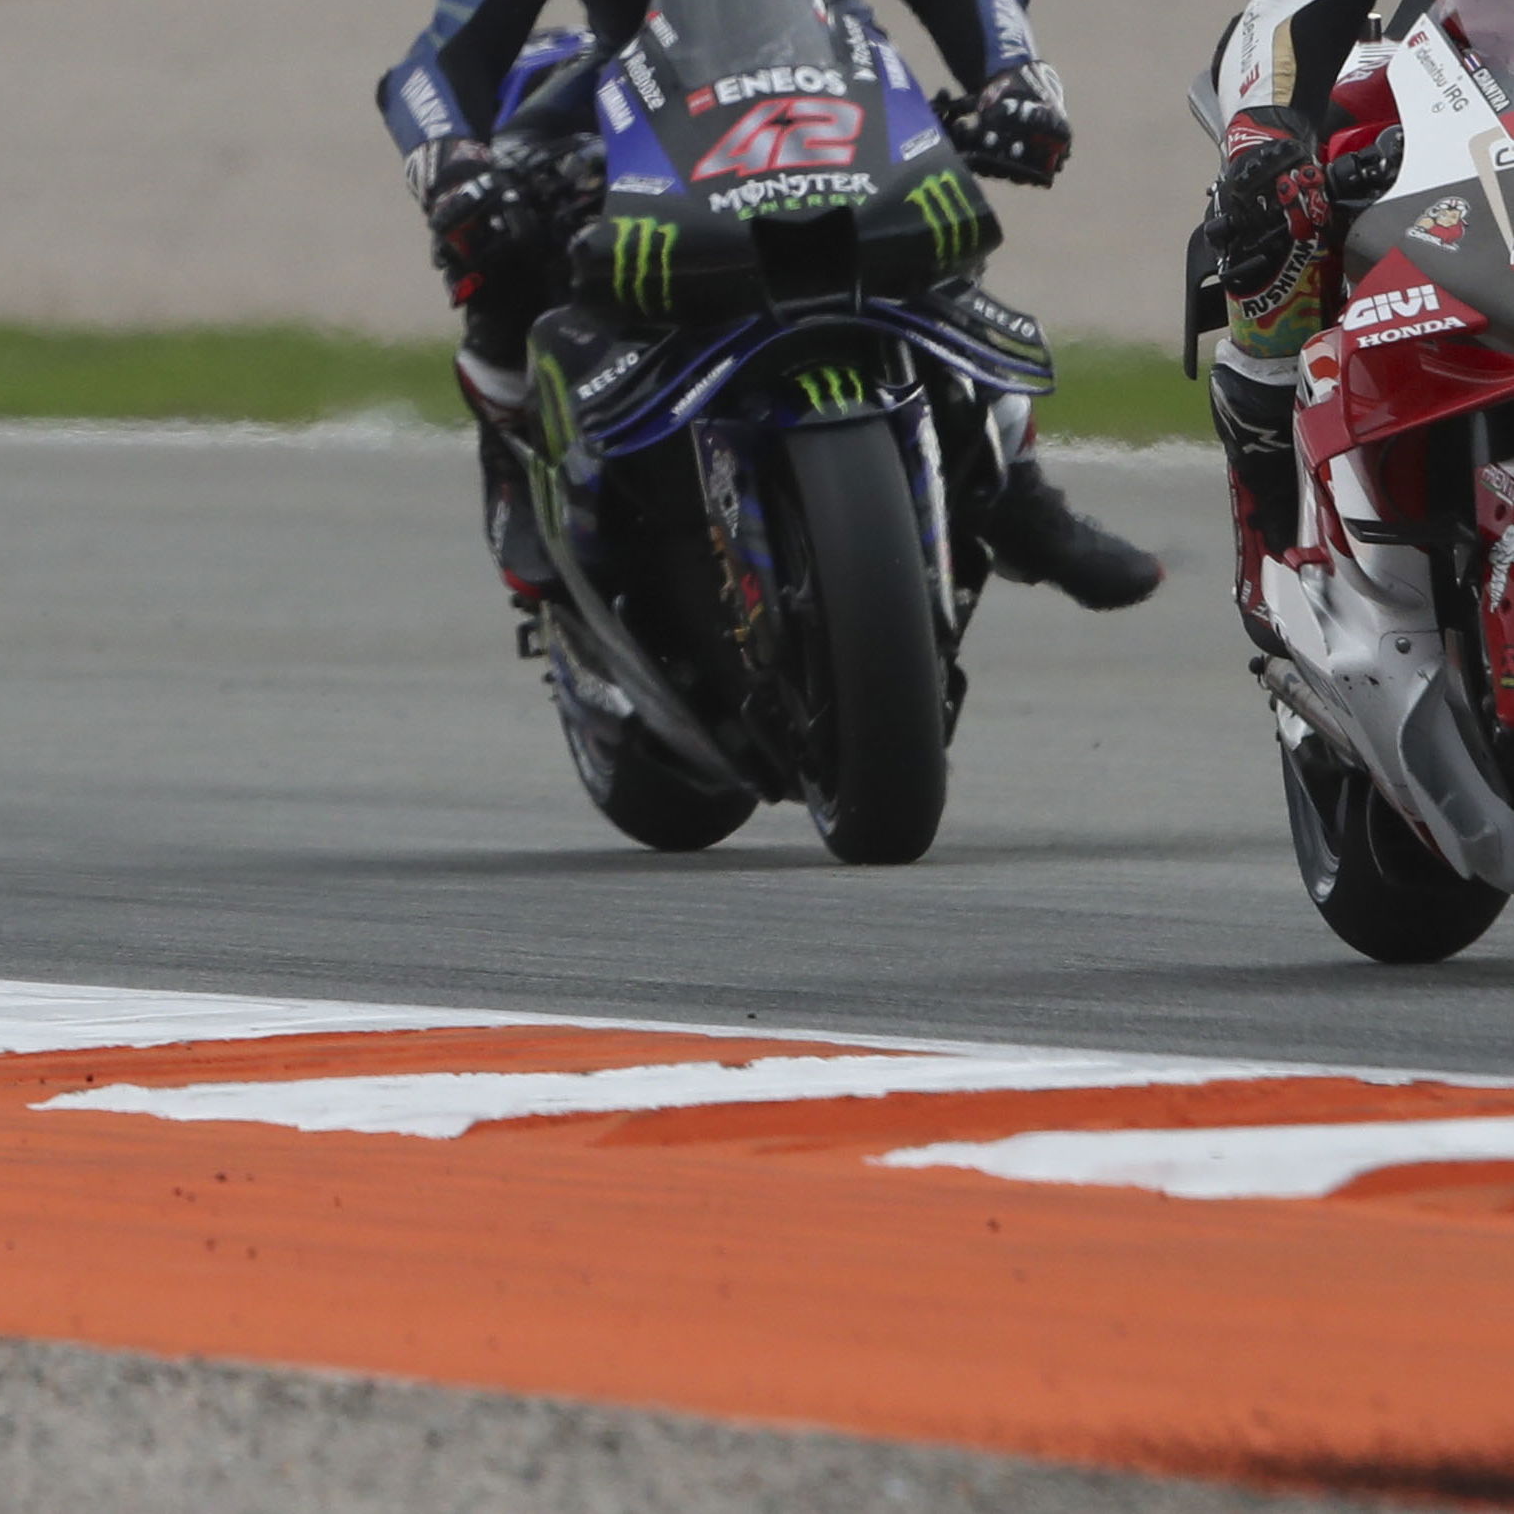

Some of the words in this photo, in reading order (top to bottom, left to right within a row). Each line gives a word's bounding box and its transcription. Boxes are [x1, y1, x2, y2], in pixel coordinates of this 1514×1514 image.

[713, 65, 848, 106] ENEOS
[1442, 83, 1469, 113] IRG
[1473, 67, 1511, 112] CHANTRA
[690, 96, 866, 182] 42
[1342, 283, 1440, 332] GIVI
[1356, 315, 1467, 349] HONDA
